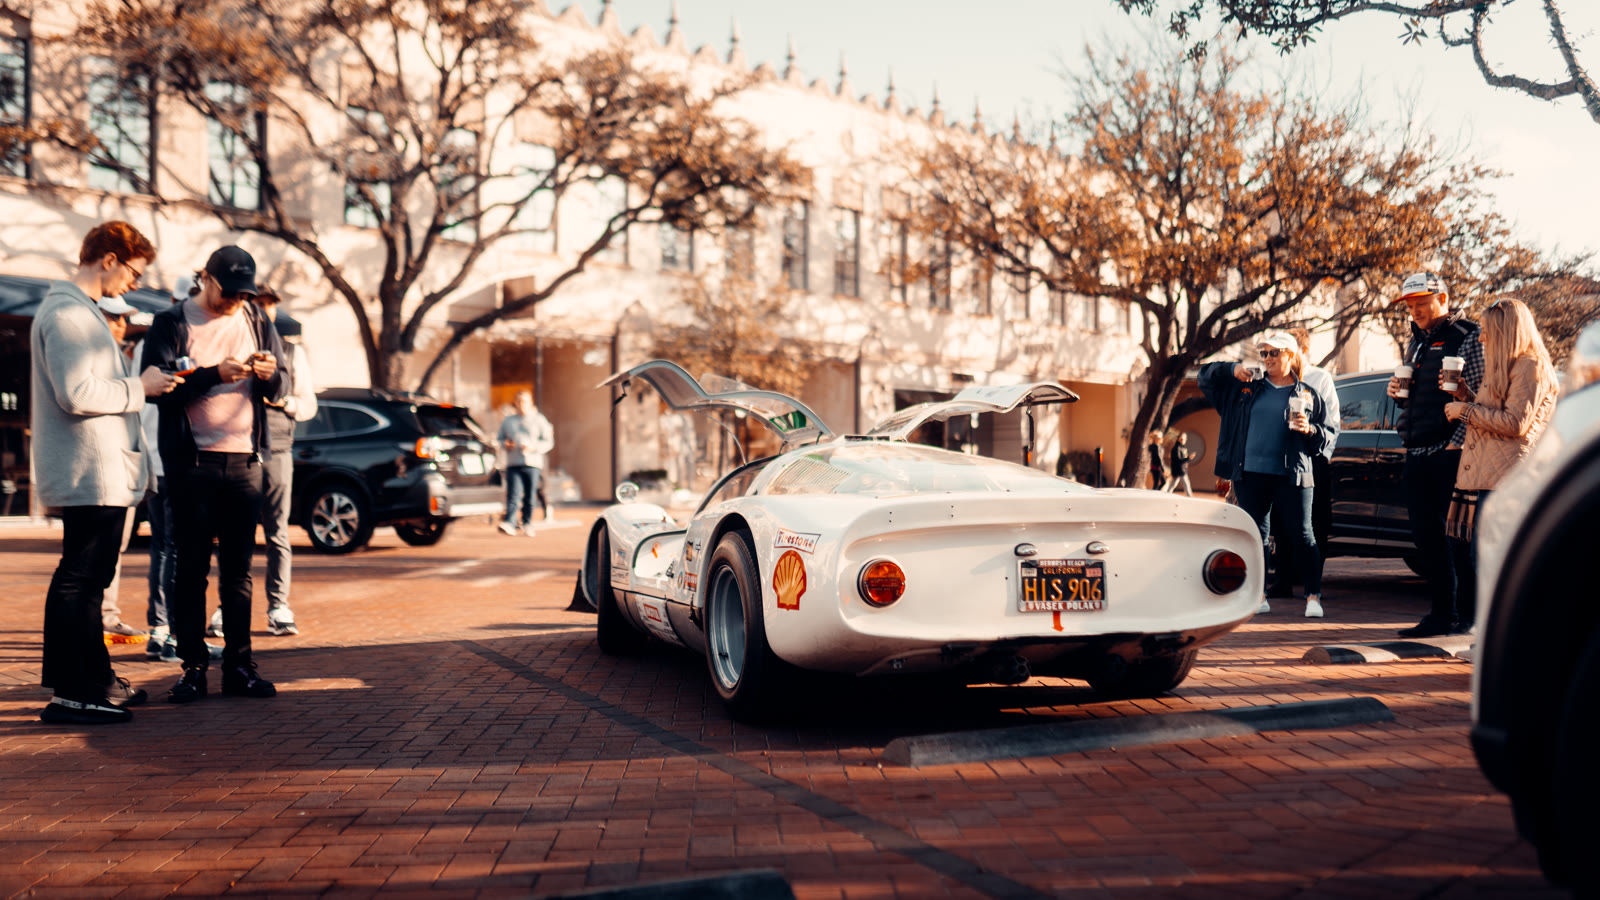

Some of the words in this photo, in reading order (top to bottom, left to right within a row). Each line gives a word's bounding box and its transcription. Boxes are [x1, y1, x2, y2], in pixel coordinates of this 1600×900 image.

[777, 531, 814, 548] Firestone
[1024, 578, 1063, 601] HIS
[1068, 578, 1102, 601] 906
[1035, 602, 1064, 610] VASEK
[1066, 602, 1094, 610] POLAK
